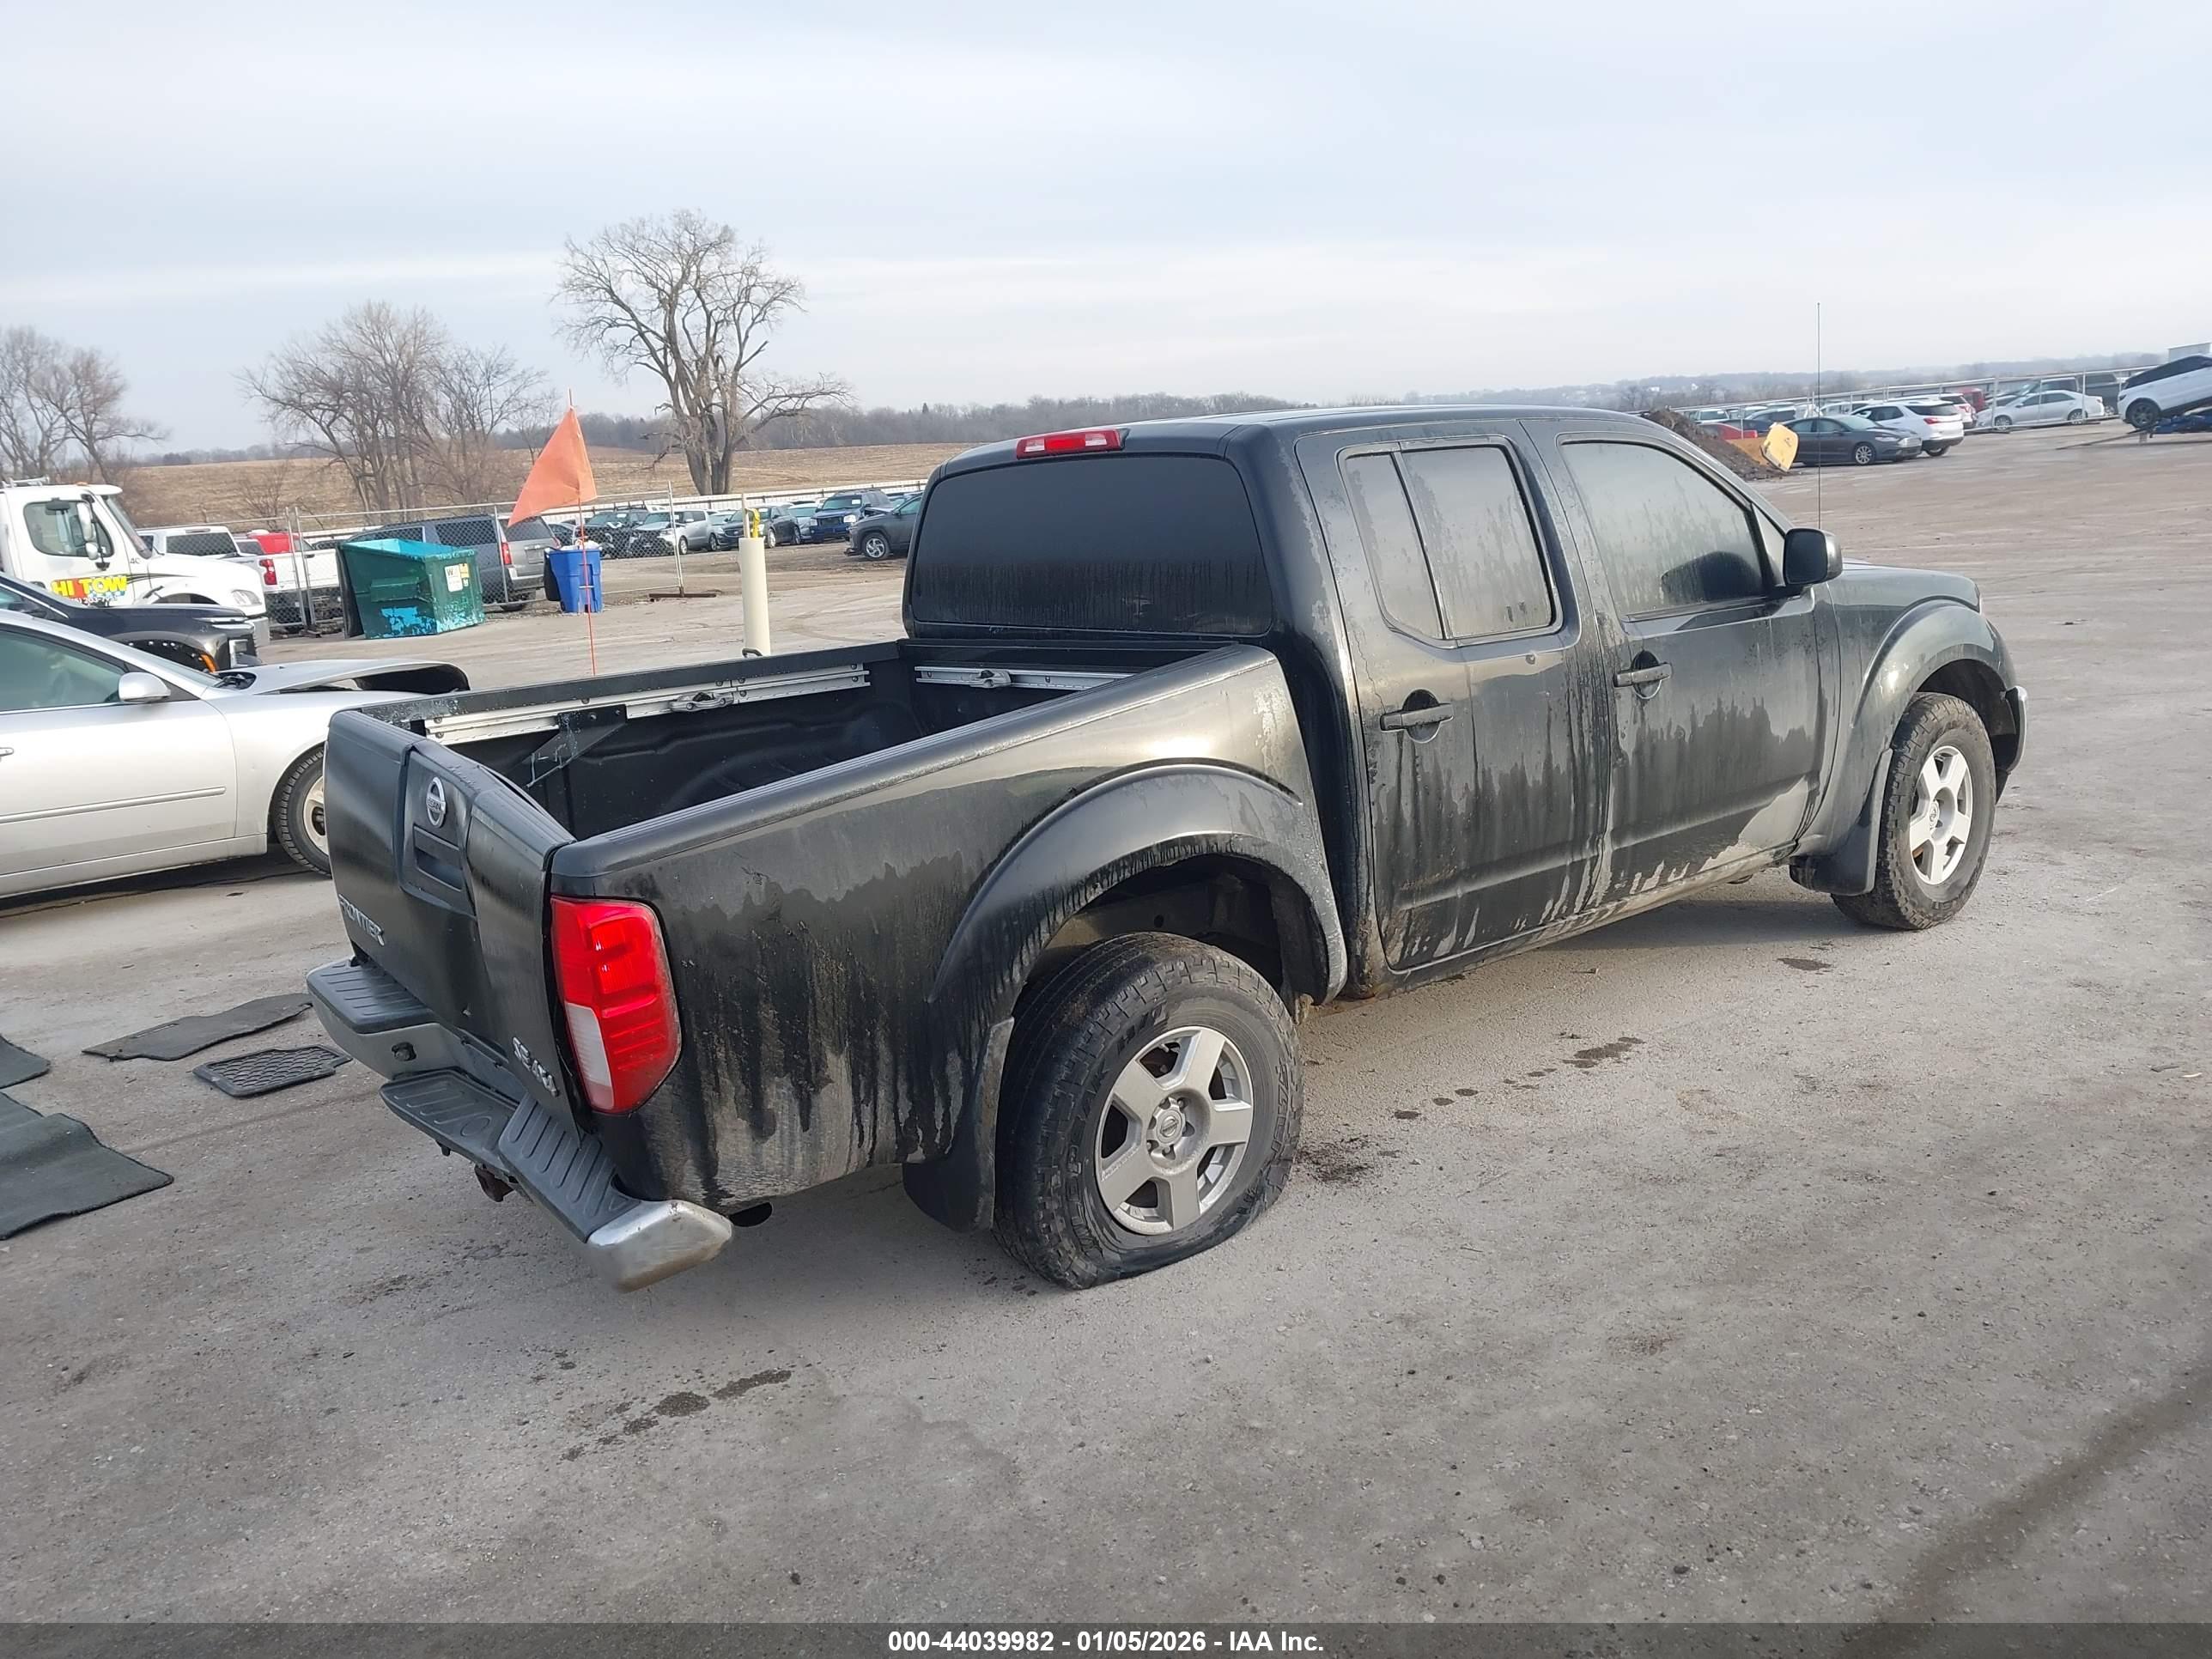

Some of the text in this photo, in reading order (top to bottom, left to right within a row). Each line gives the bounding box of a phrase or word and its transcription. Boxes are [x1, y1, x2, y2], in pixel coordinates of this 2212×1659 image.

[52, 575, 127, 596] HI TOW
[512, 1036, 532, 1073] SE
